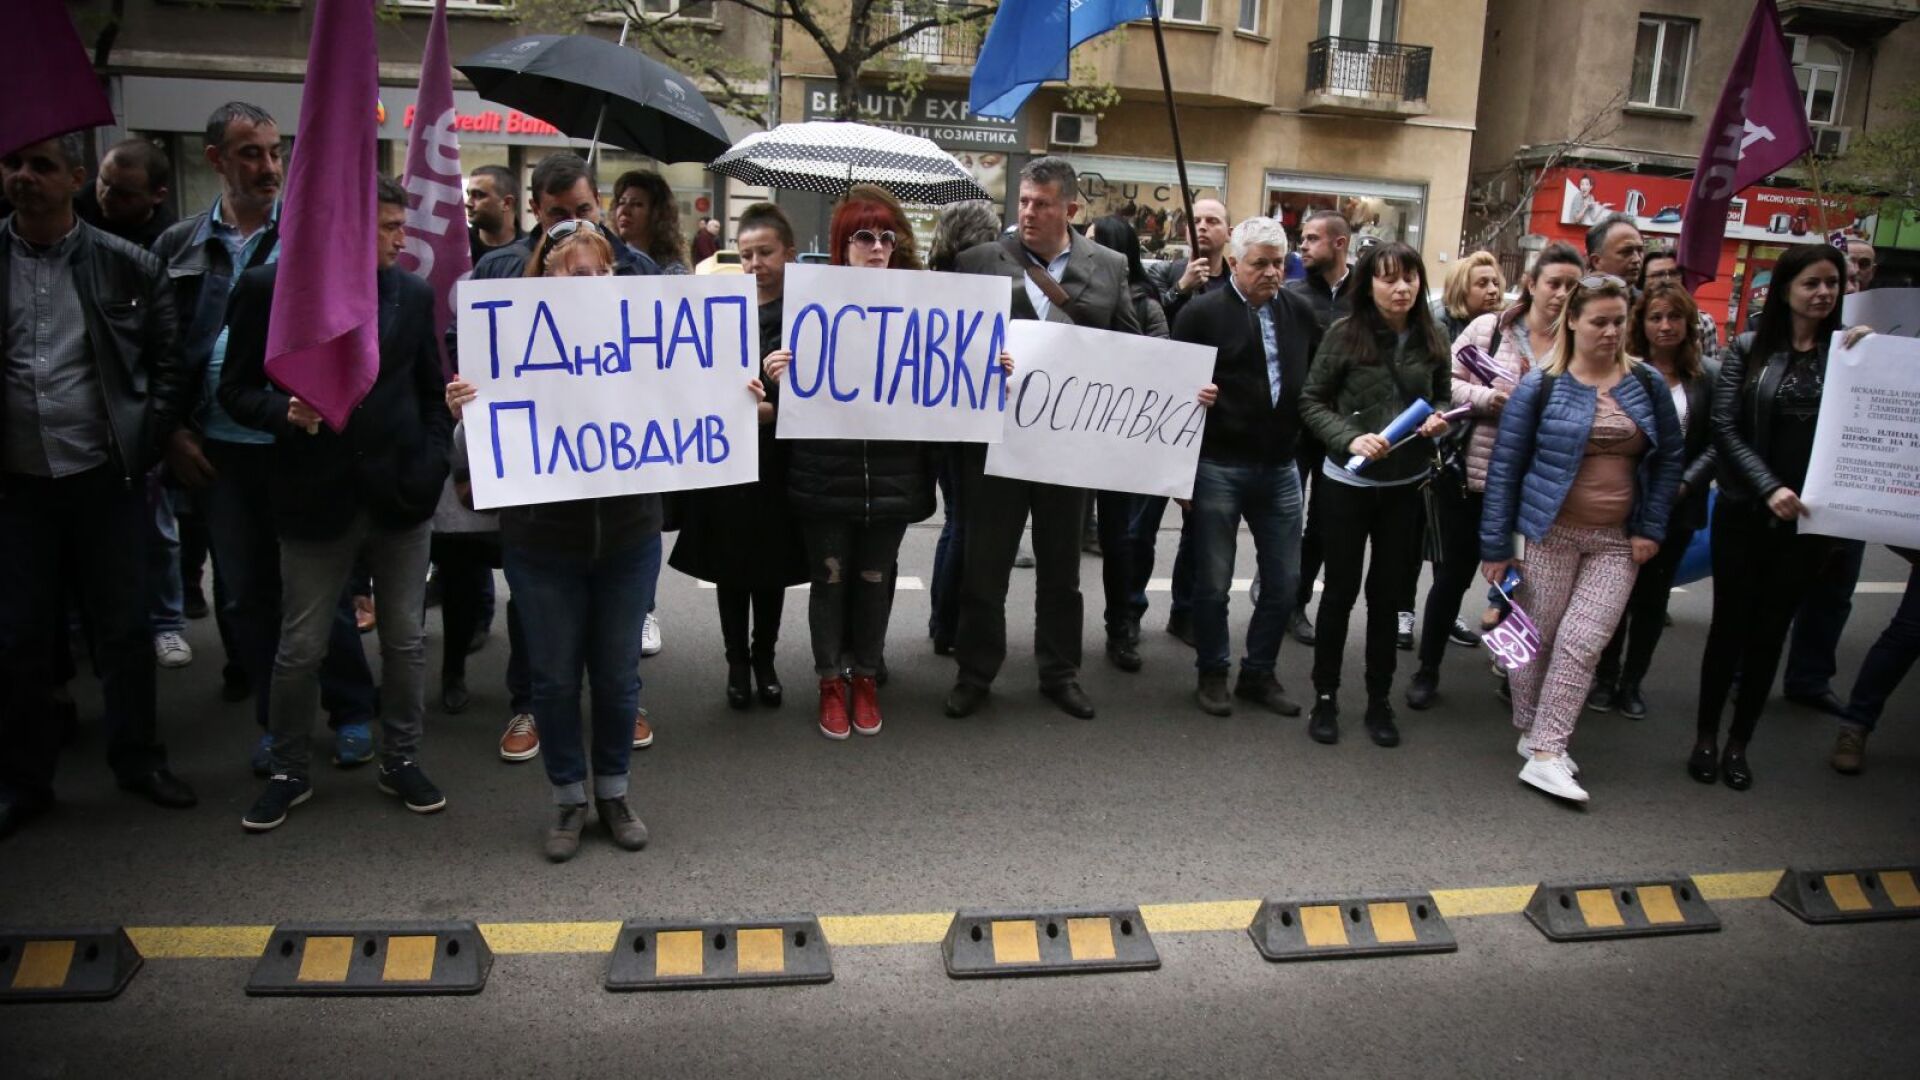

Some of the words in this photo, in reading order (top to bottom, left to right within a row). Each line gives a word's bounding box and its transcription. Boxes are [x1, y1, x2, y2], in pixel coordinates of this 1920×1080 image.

[919, 127, 930, 139] И
[934, 129, 1017, 144] КОЗМЕТИКА
[789, 303, 1006, 412] ОСТАВКА
[1842, 433, 1884, 443] ШЕФОВЕ
[1890, 438, 1903, 446] НА
